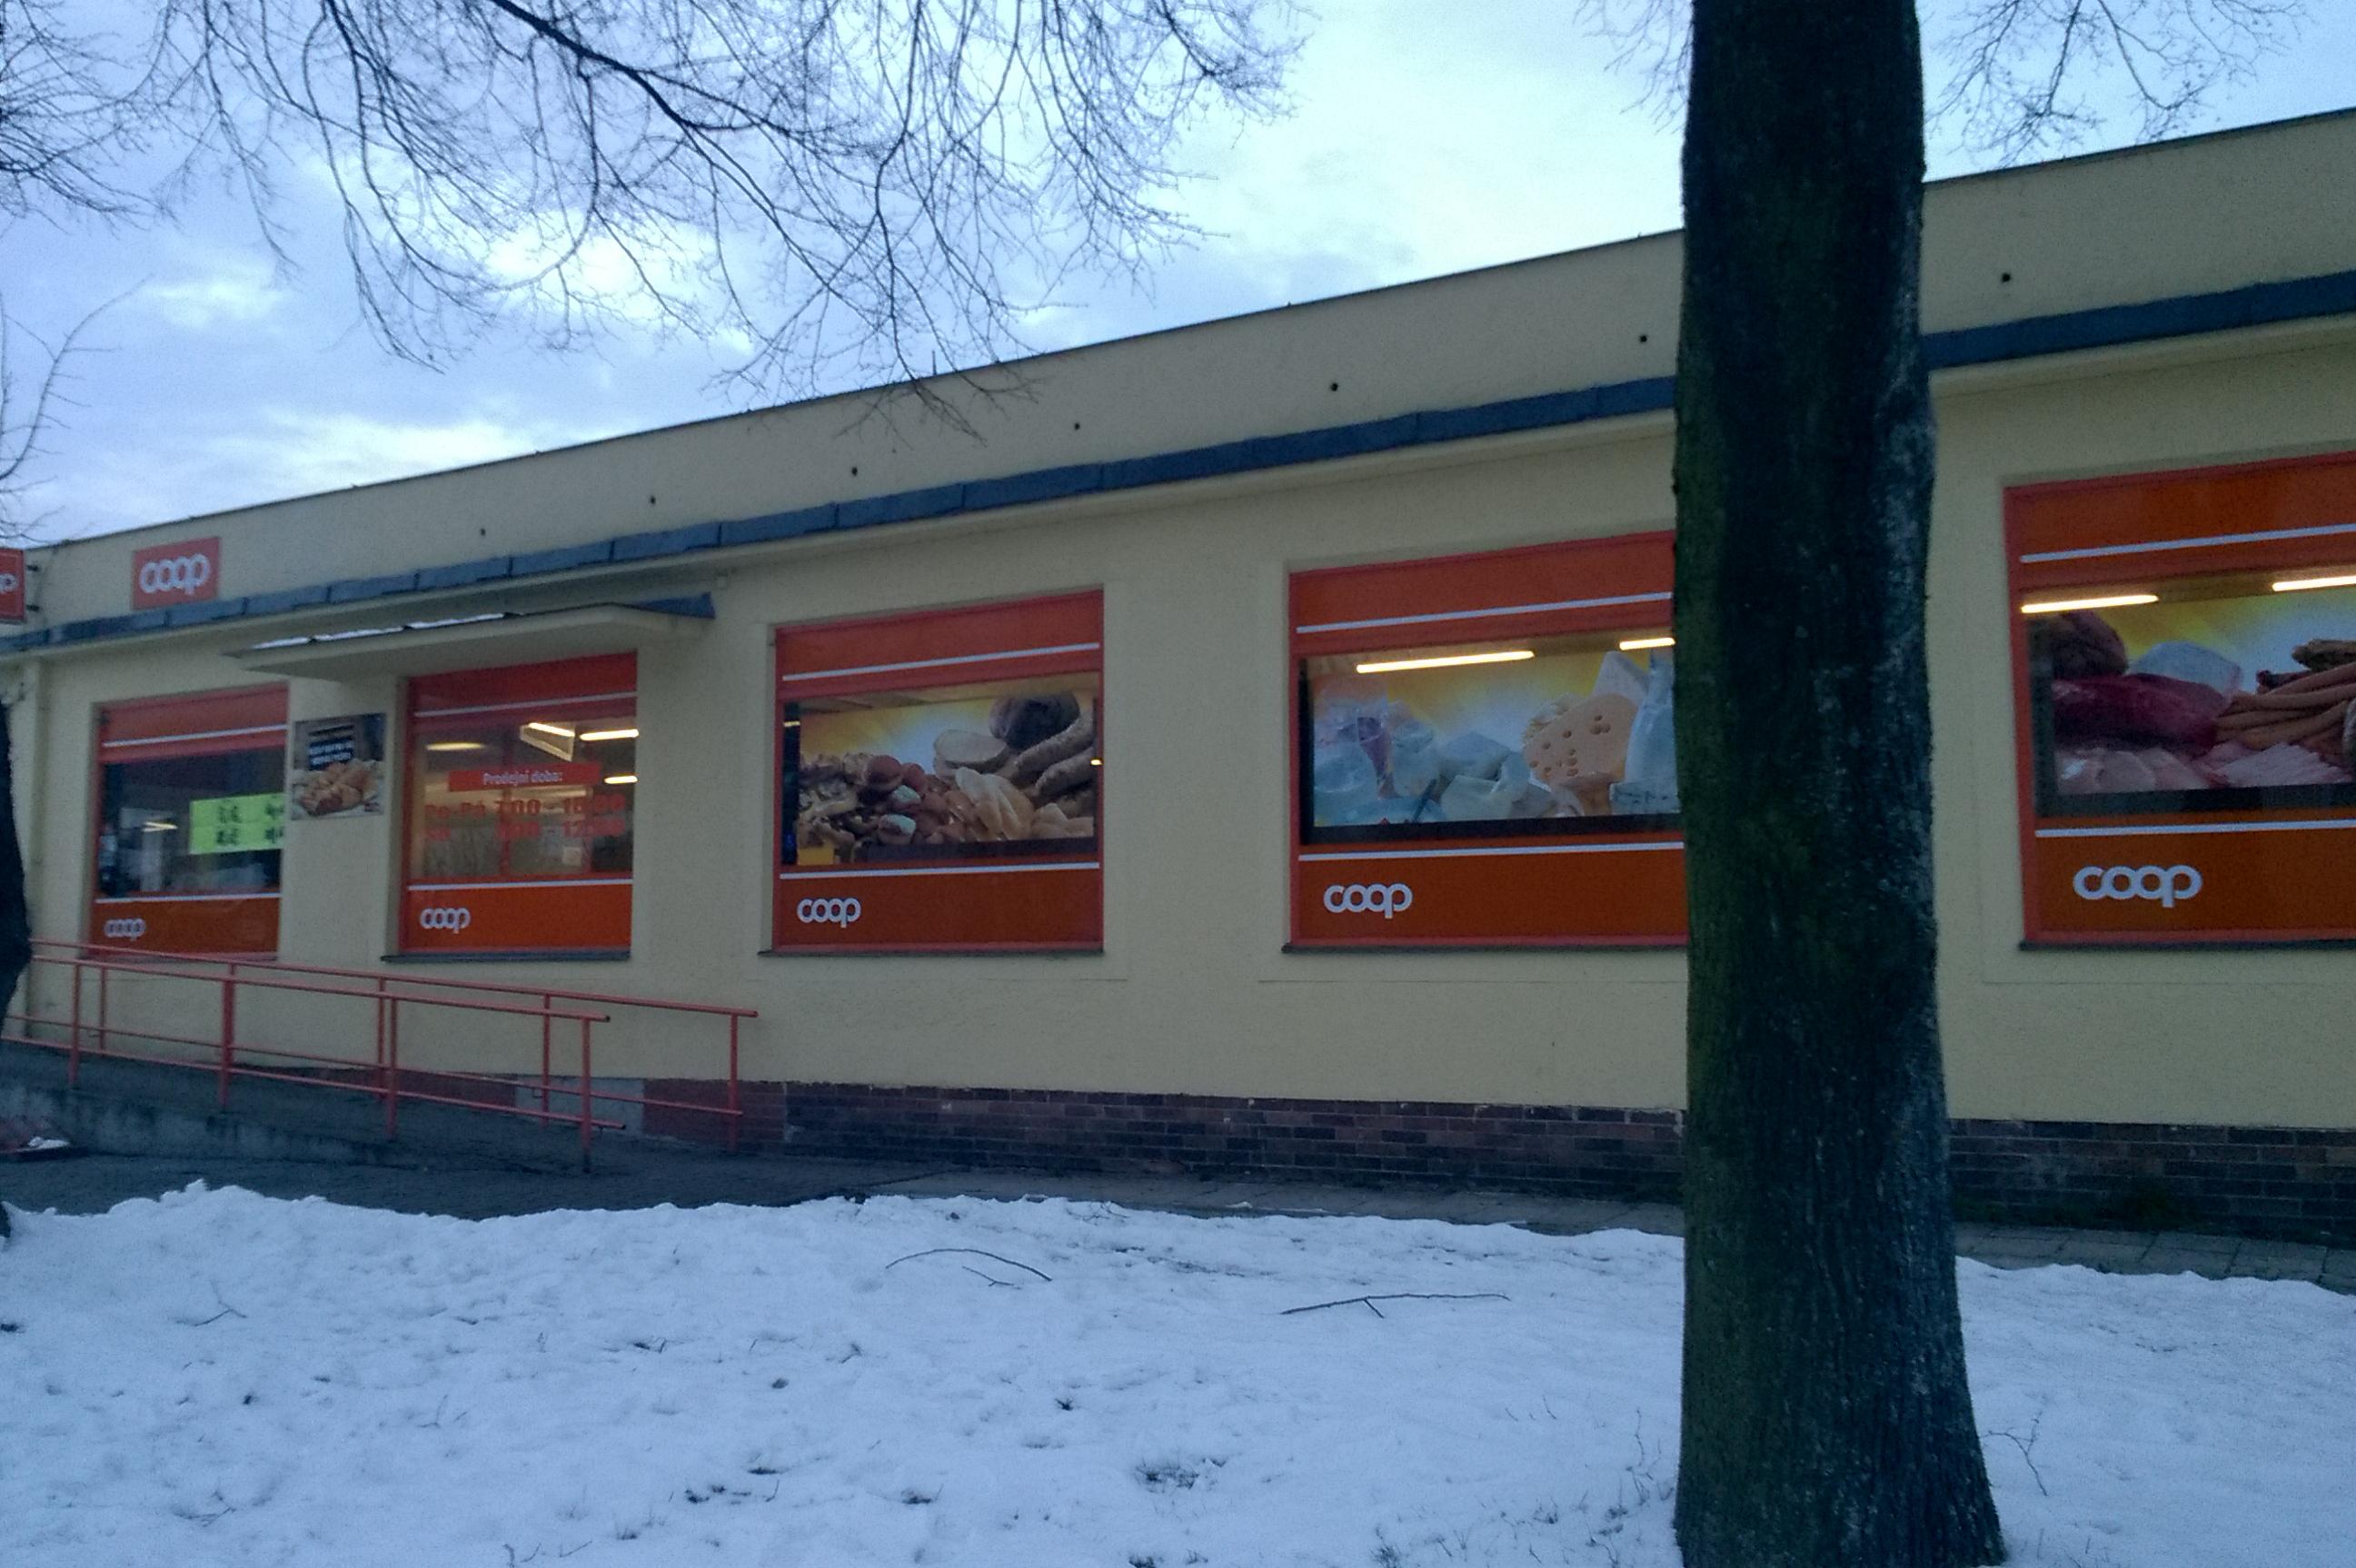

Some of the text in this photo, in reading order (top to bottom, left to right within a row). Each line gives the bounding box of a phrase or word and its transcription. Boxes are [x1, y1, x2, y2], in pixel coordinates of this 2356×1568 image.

[139, 553, 210, 595] coop
[1324, 884, 1413, 918] coop
[2073, 865, 2202, 908] coop
[420, 908, 471, 933] coop
[797, 898, 861, 928] coop
[104, 918, 146, 942] coop
